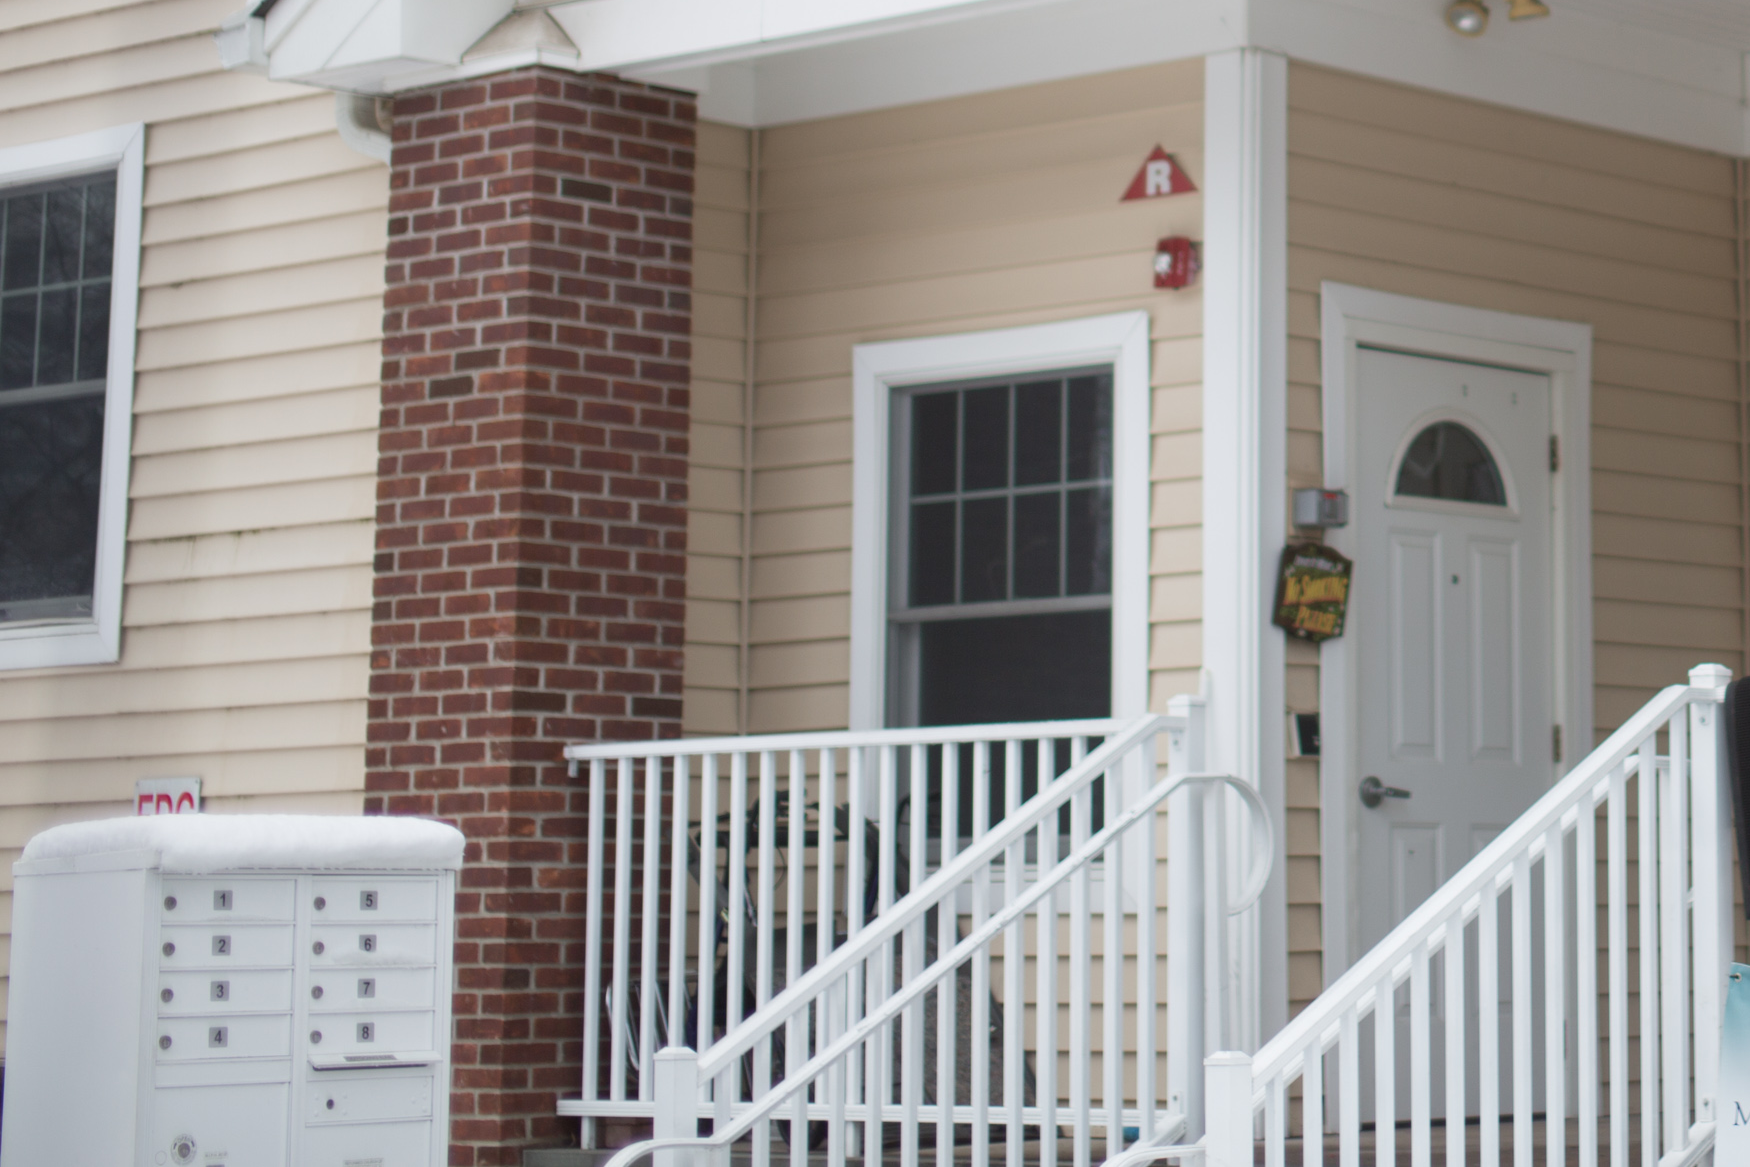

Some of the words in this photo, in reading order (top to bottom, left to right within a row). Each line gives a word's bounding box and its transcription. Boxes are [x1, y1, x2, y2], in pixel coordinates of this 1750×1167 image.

[1145, 159, 1171, 196] R
[220, 893, 226, 907] 1
[365, 893, 373, 907] 5
[218, 938, 226, 953] 2
[364, 937, 372, 951] 6
[216, 984, 224, 998] 3
[363, 981, 371, 995] 7
[214, 1029, 223, 1044] 4
[362, 1025, 370, 1040] 8
